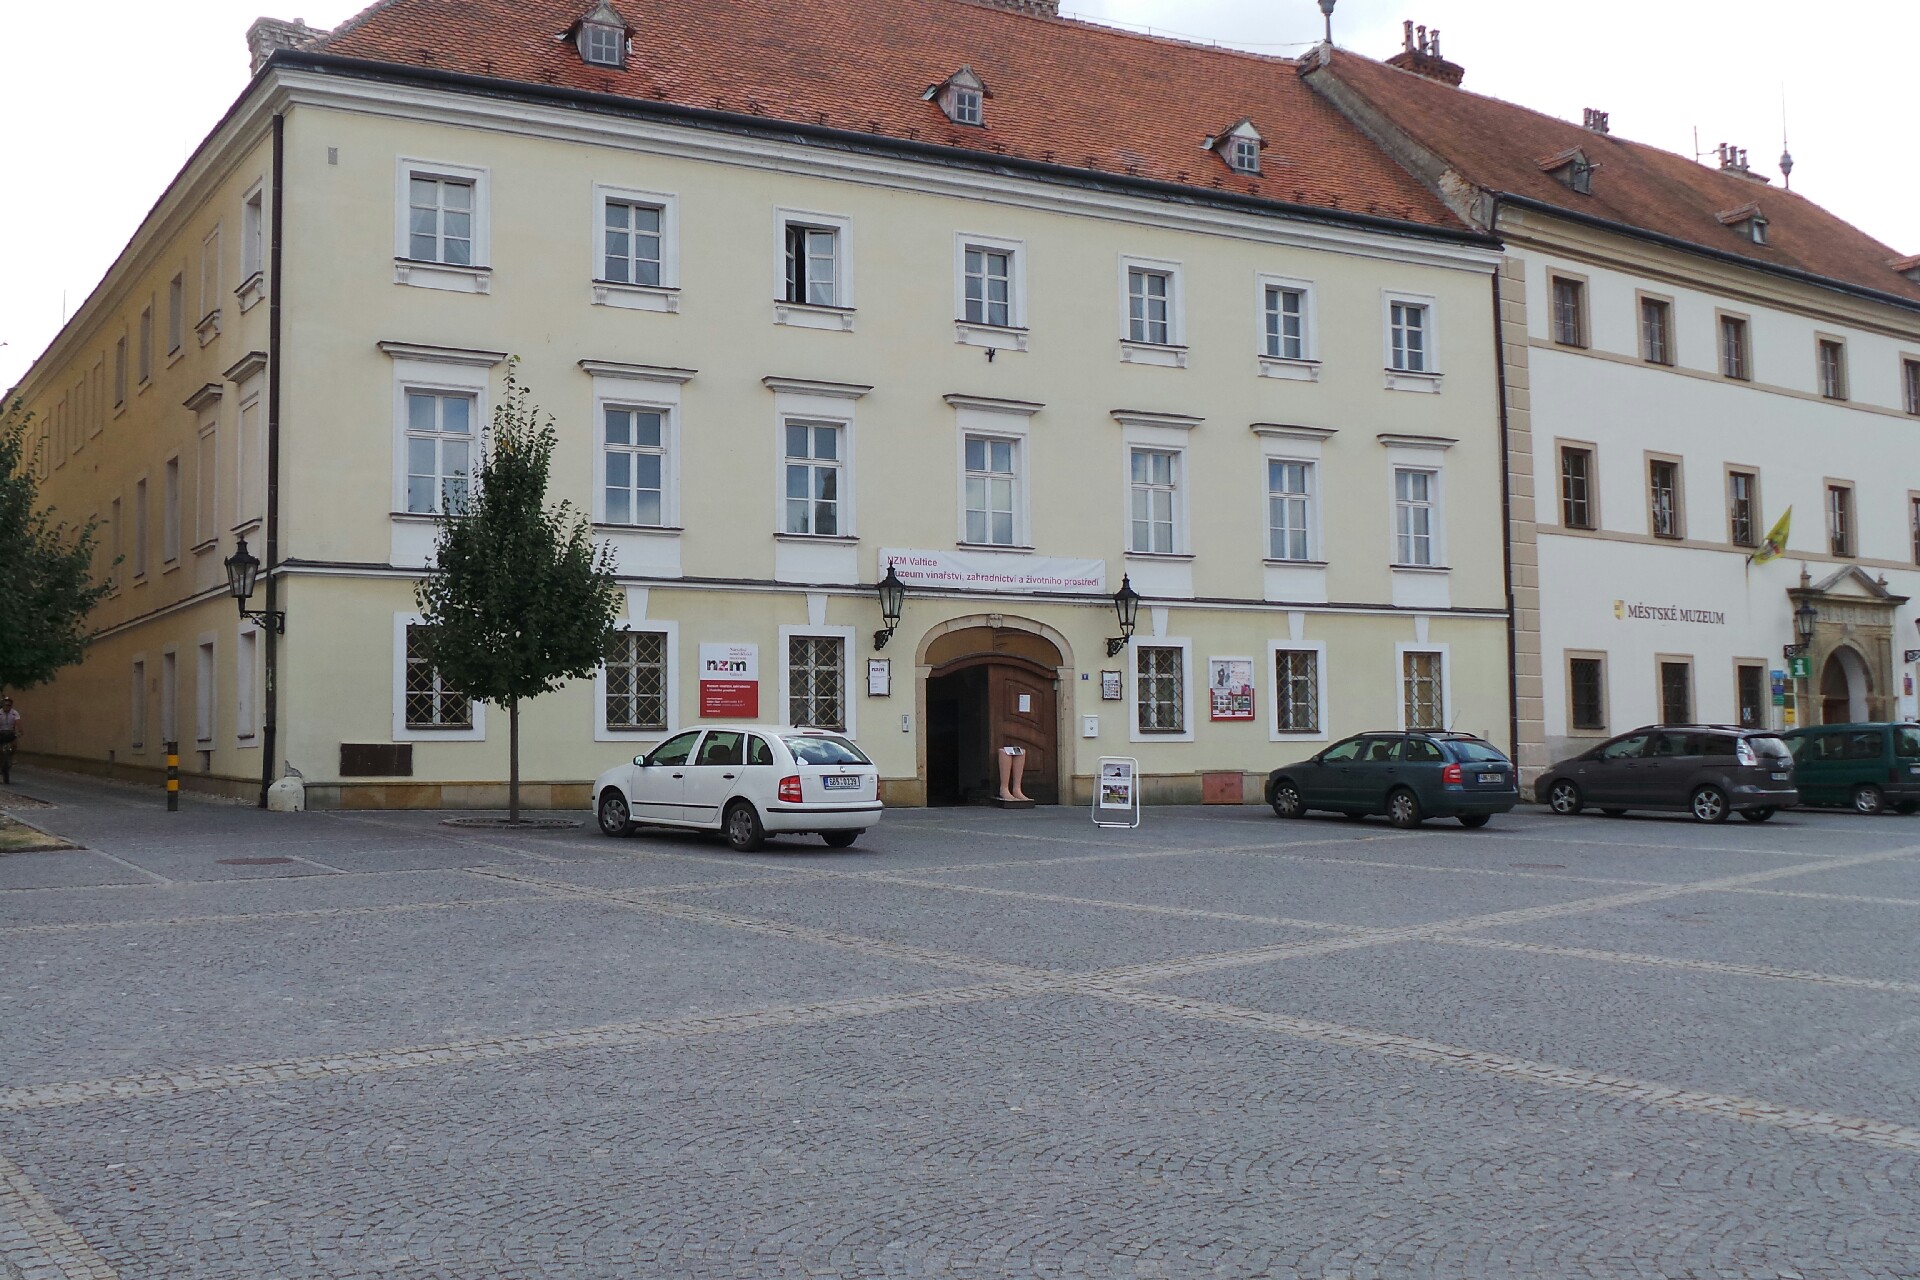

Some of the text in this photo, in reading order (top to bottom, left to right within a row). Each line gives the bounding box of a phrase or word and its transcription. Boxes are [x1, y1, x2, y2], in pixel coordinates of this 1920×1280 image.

[887, 556, 938, 567] NZM Valtice
[895, 570, 924, 579] uzeum
[1627, 602, 1725, 625] MĚSTSKÉ MUZEUM
[706, 660, 747, 672] nzm
